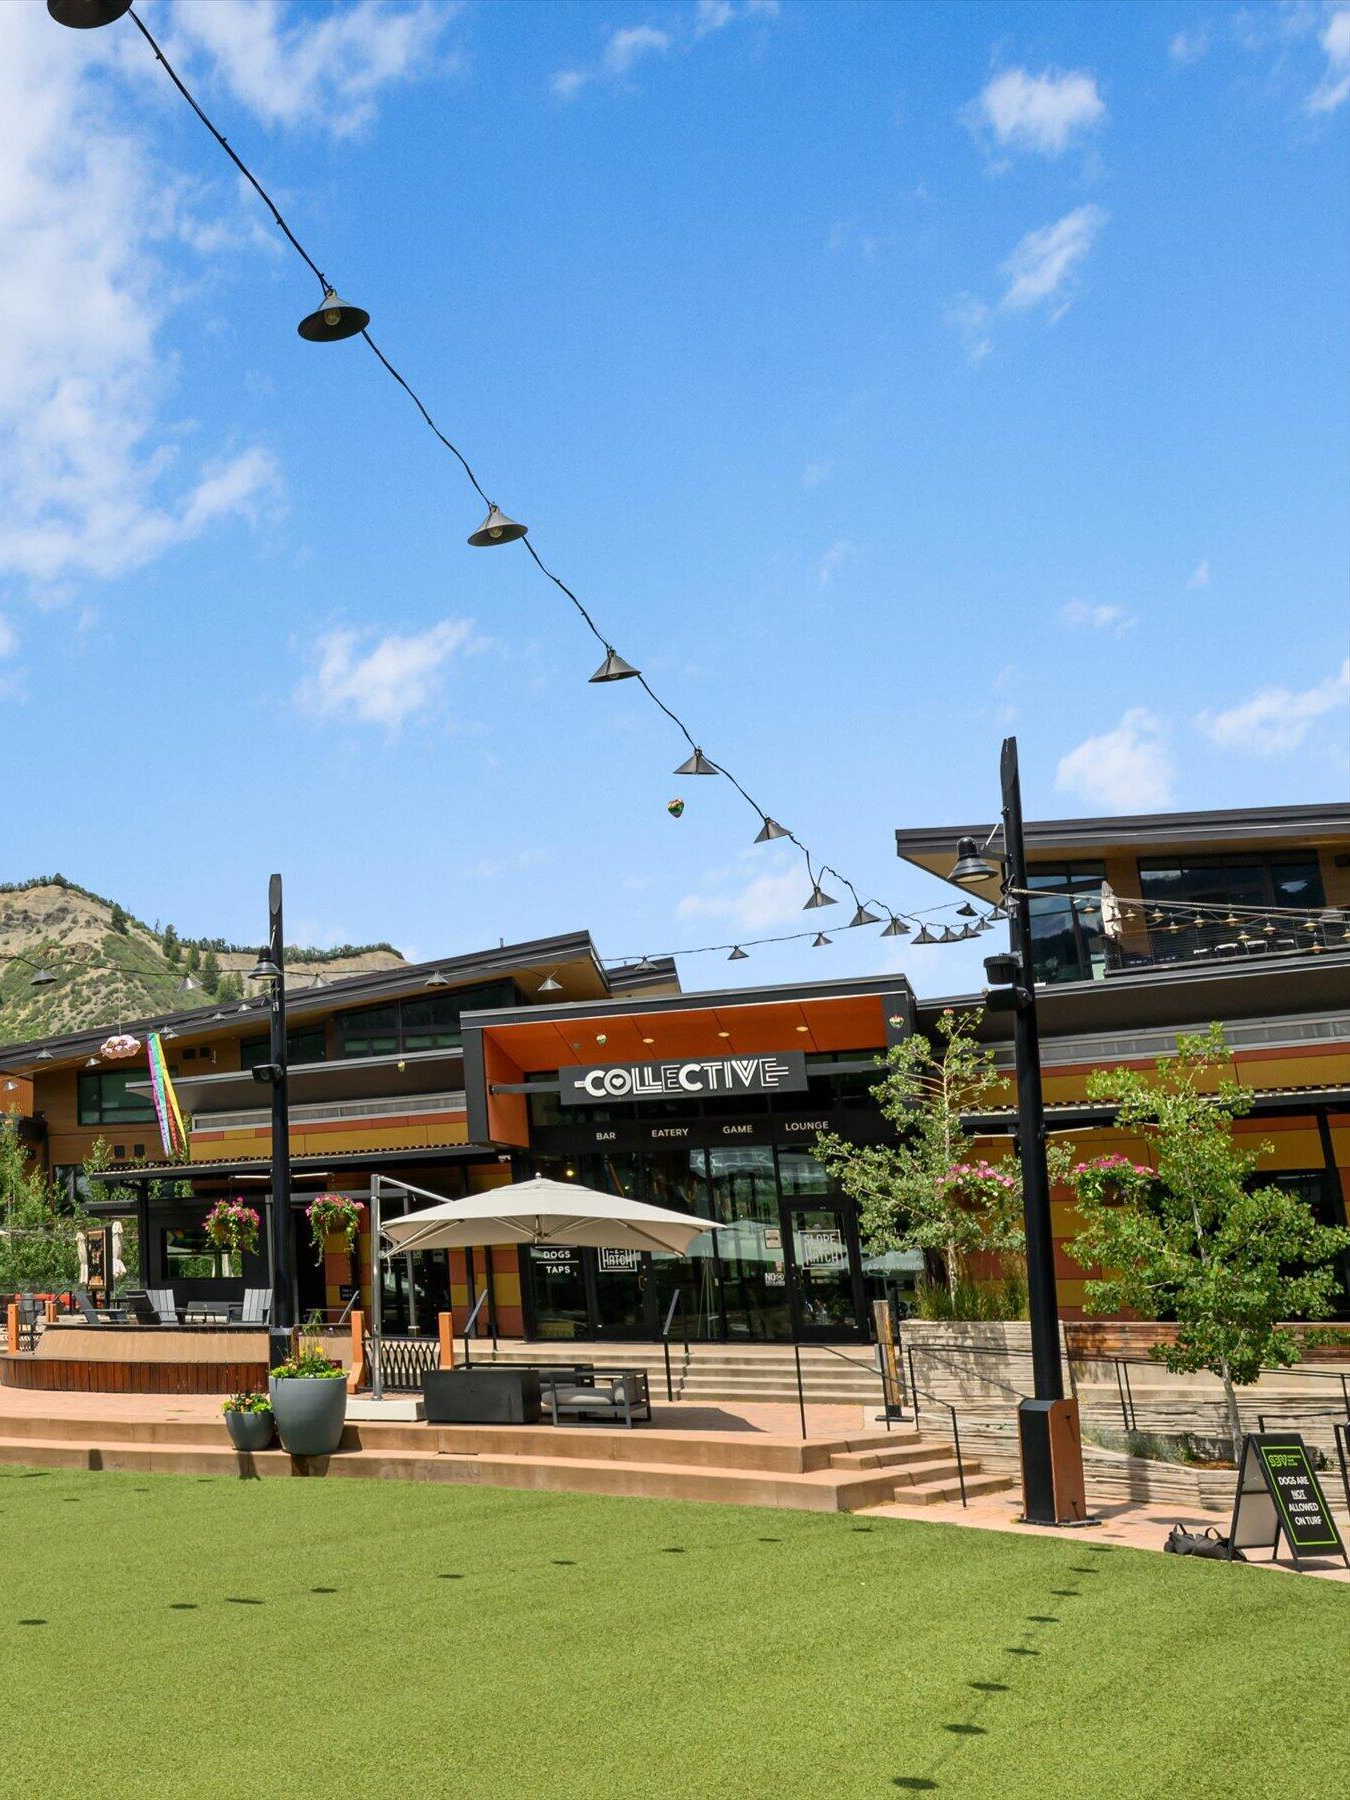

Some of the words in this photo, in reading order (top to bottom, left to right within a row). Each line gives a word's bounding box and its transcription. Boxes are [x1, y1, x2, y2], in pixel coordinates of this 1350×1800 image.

[574, 1058, 789, 1097] COLLECTIVE
[596, 1131, 616, 1141] BAR
[651, 1128, 689, 1138] EATERY
[722, 1125, 753, 1134] GAME
[785, 1120, 829, 1132] LOUNGE
[804, 1234, 836, 1244] SLOPE
[543, 1250, 571, 1259] DOGS
[546, 1265, 571, 1274] TAPS
[1278, 1476, 1297, 1485] DOGS
[1296, 1476, 1310, 1485] ARE
[1291, 1490, 1306, 1499] NOT
[1289, 1503, 1319, 1512] ALLOWED
[1295, 1517, 1306, 1525] ON
[1305, 1516, 1322, 1525] TURF
